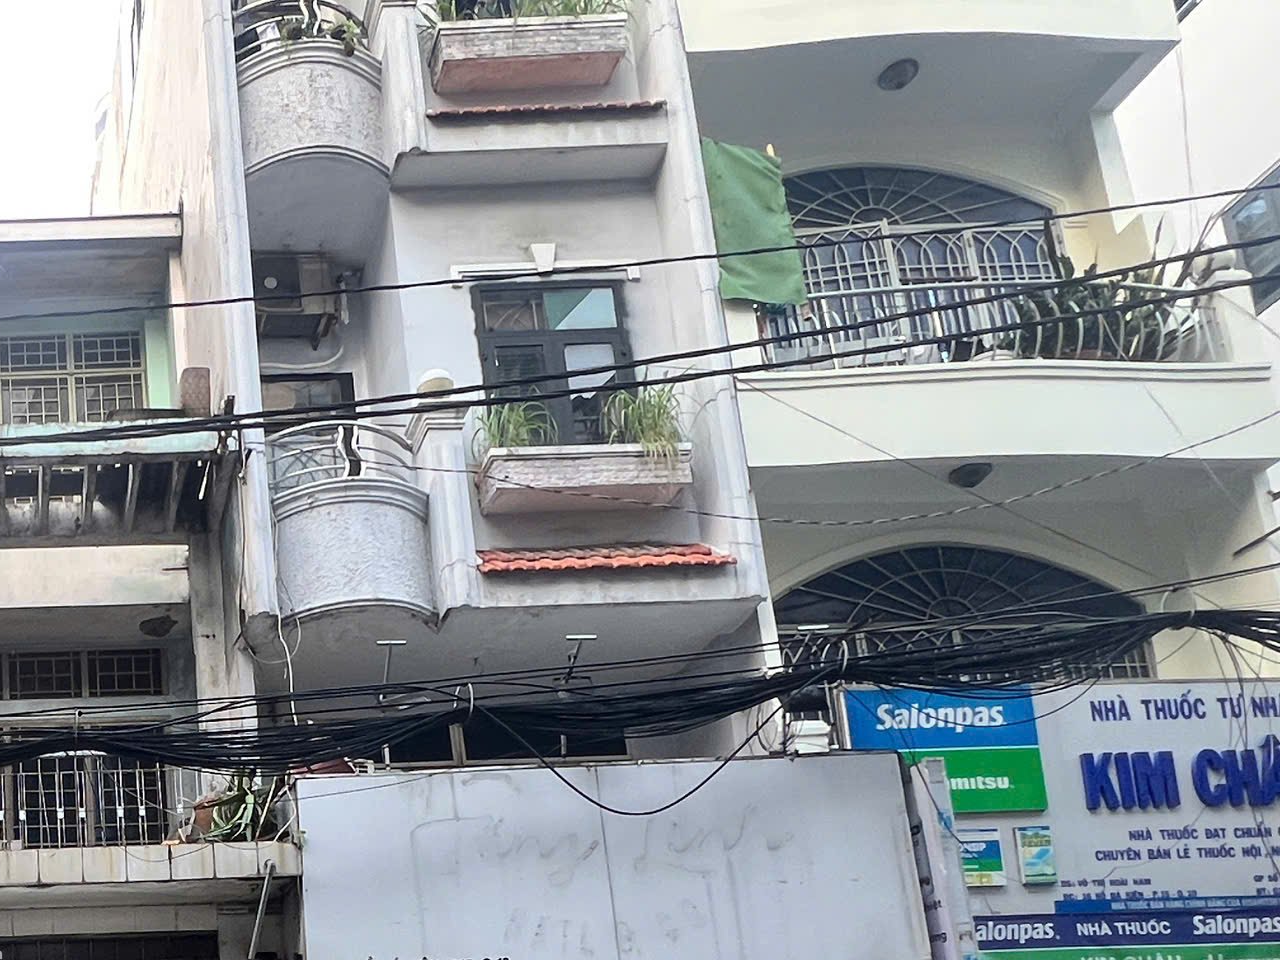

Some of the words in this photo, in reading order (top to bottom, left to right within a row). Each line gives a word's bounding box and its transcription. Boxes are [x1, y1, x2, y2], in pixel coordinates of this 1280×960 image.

[1090, 694, 1131, 721] NHÀ
[1141, 689, 1206, 720] THUỐC
[876, 703, 1004, 733] Salonpas
[950, 775, 1009, 790] mitsu
[1080, 750, 1181, 812] KIM
[1191, 734, 1280, 808] CHÂ
[1129, 827, 1153, 841] NHÀ
[1159, 825, 1199, 840] THUỐC
[1095, 846, 1142, 861] CHUYÊN
[1148, 845, 1171, 860] BÁN
[1197, 842, 1236, 858] THUỐC
[976, 921, 1055, 944] alonpas
[1076, 920, 1112, 936] NHÀ
[1114, 919, 1171, 935] THUỐC
